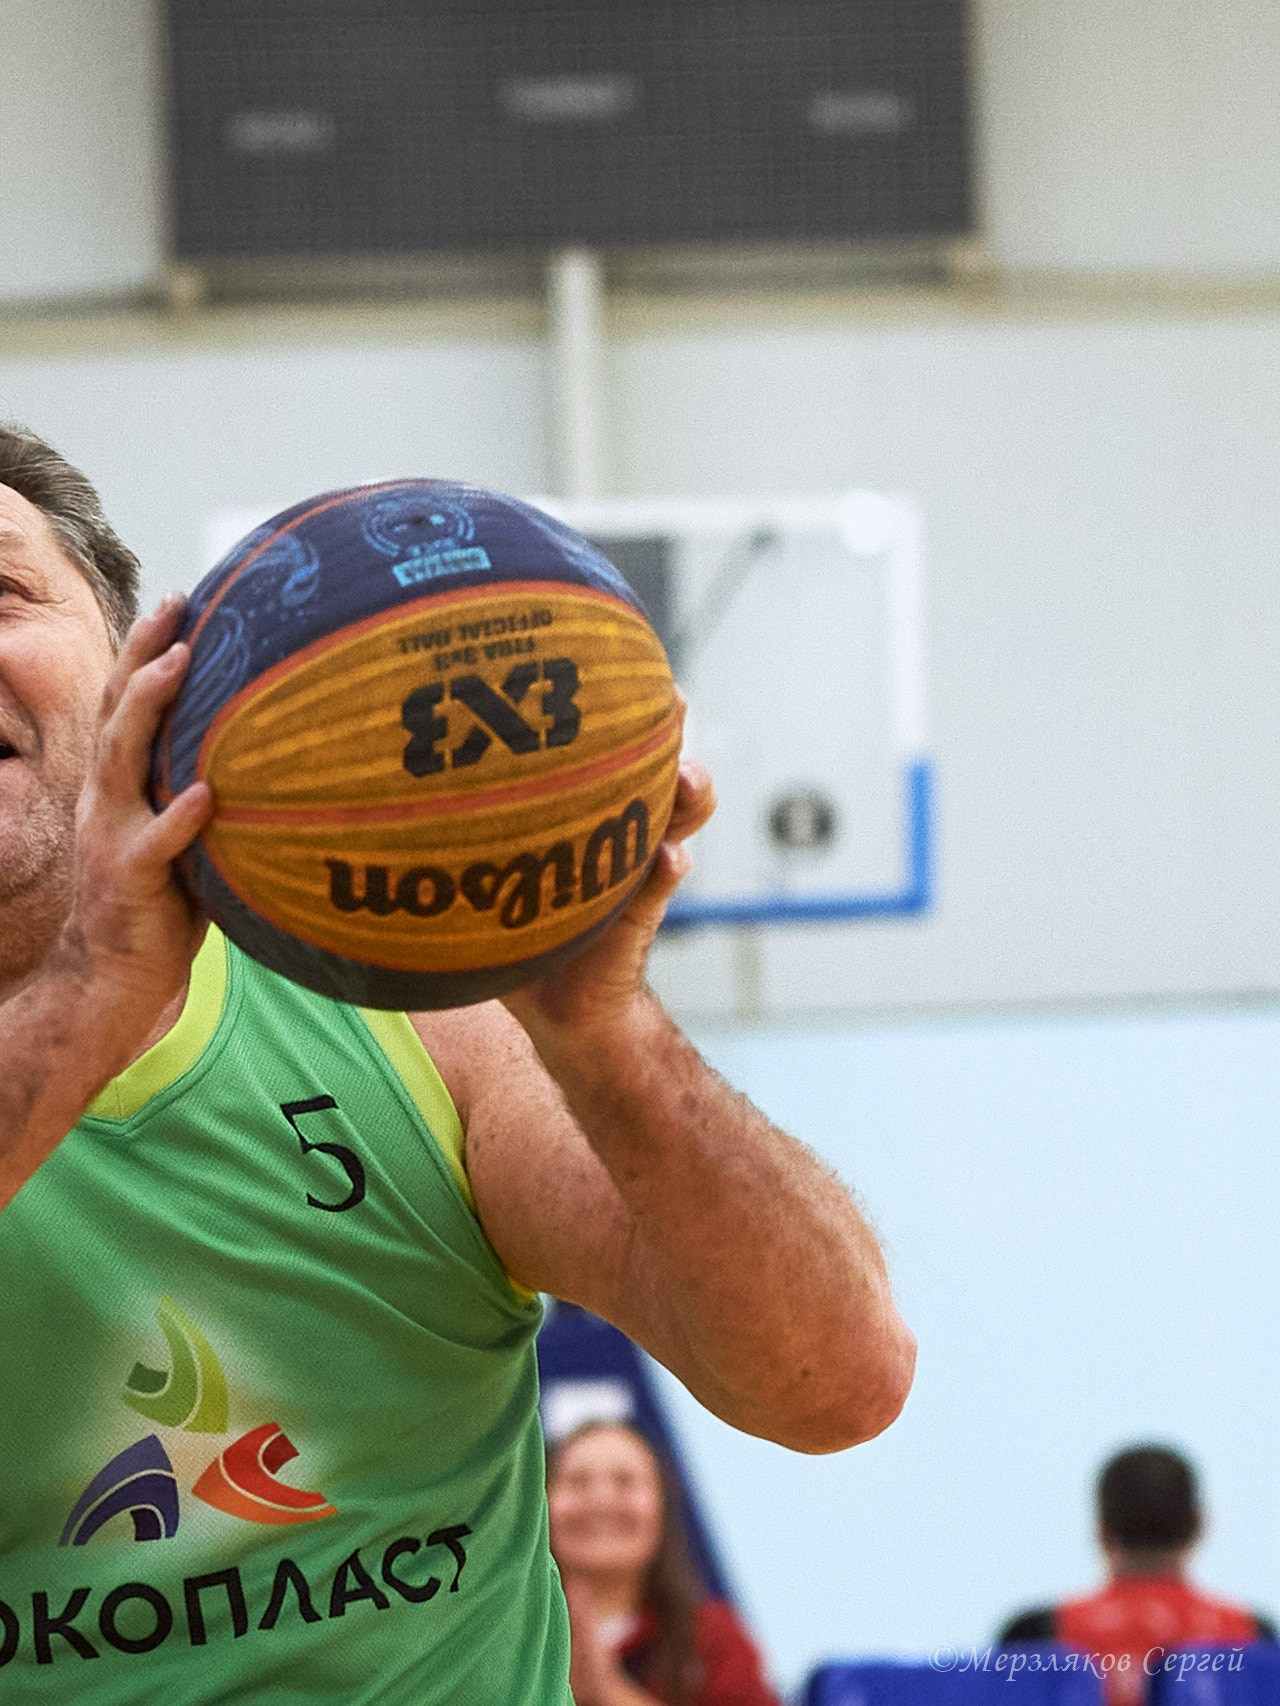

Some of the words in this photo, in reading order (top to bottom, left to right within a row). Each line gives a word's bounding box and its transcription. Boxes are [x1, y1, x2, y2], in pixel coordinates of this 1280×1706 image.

[457, 609, 553, 641] OFFICIAL
[325, 798, 649, 930] Wilson
[280, 1094, 366, 1213] 5
